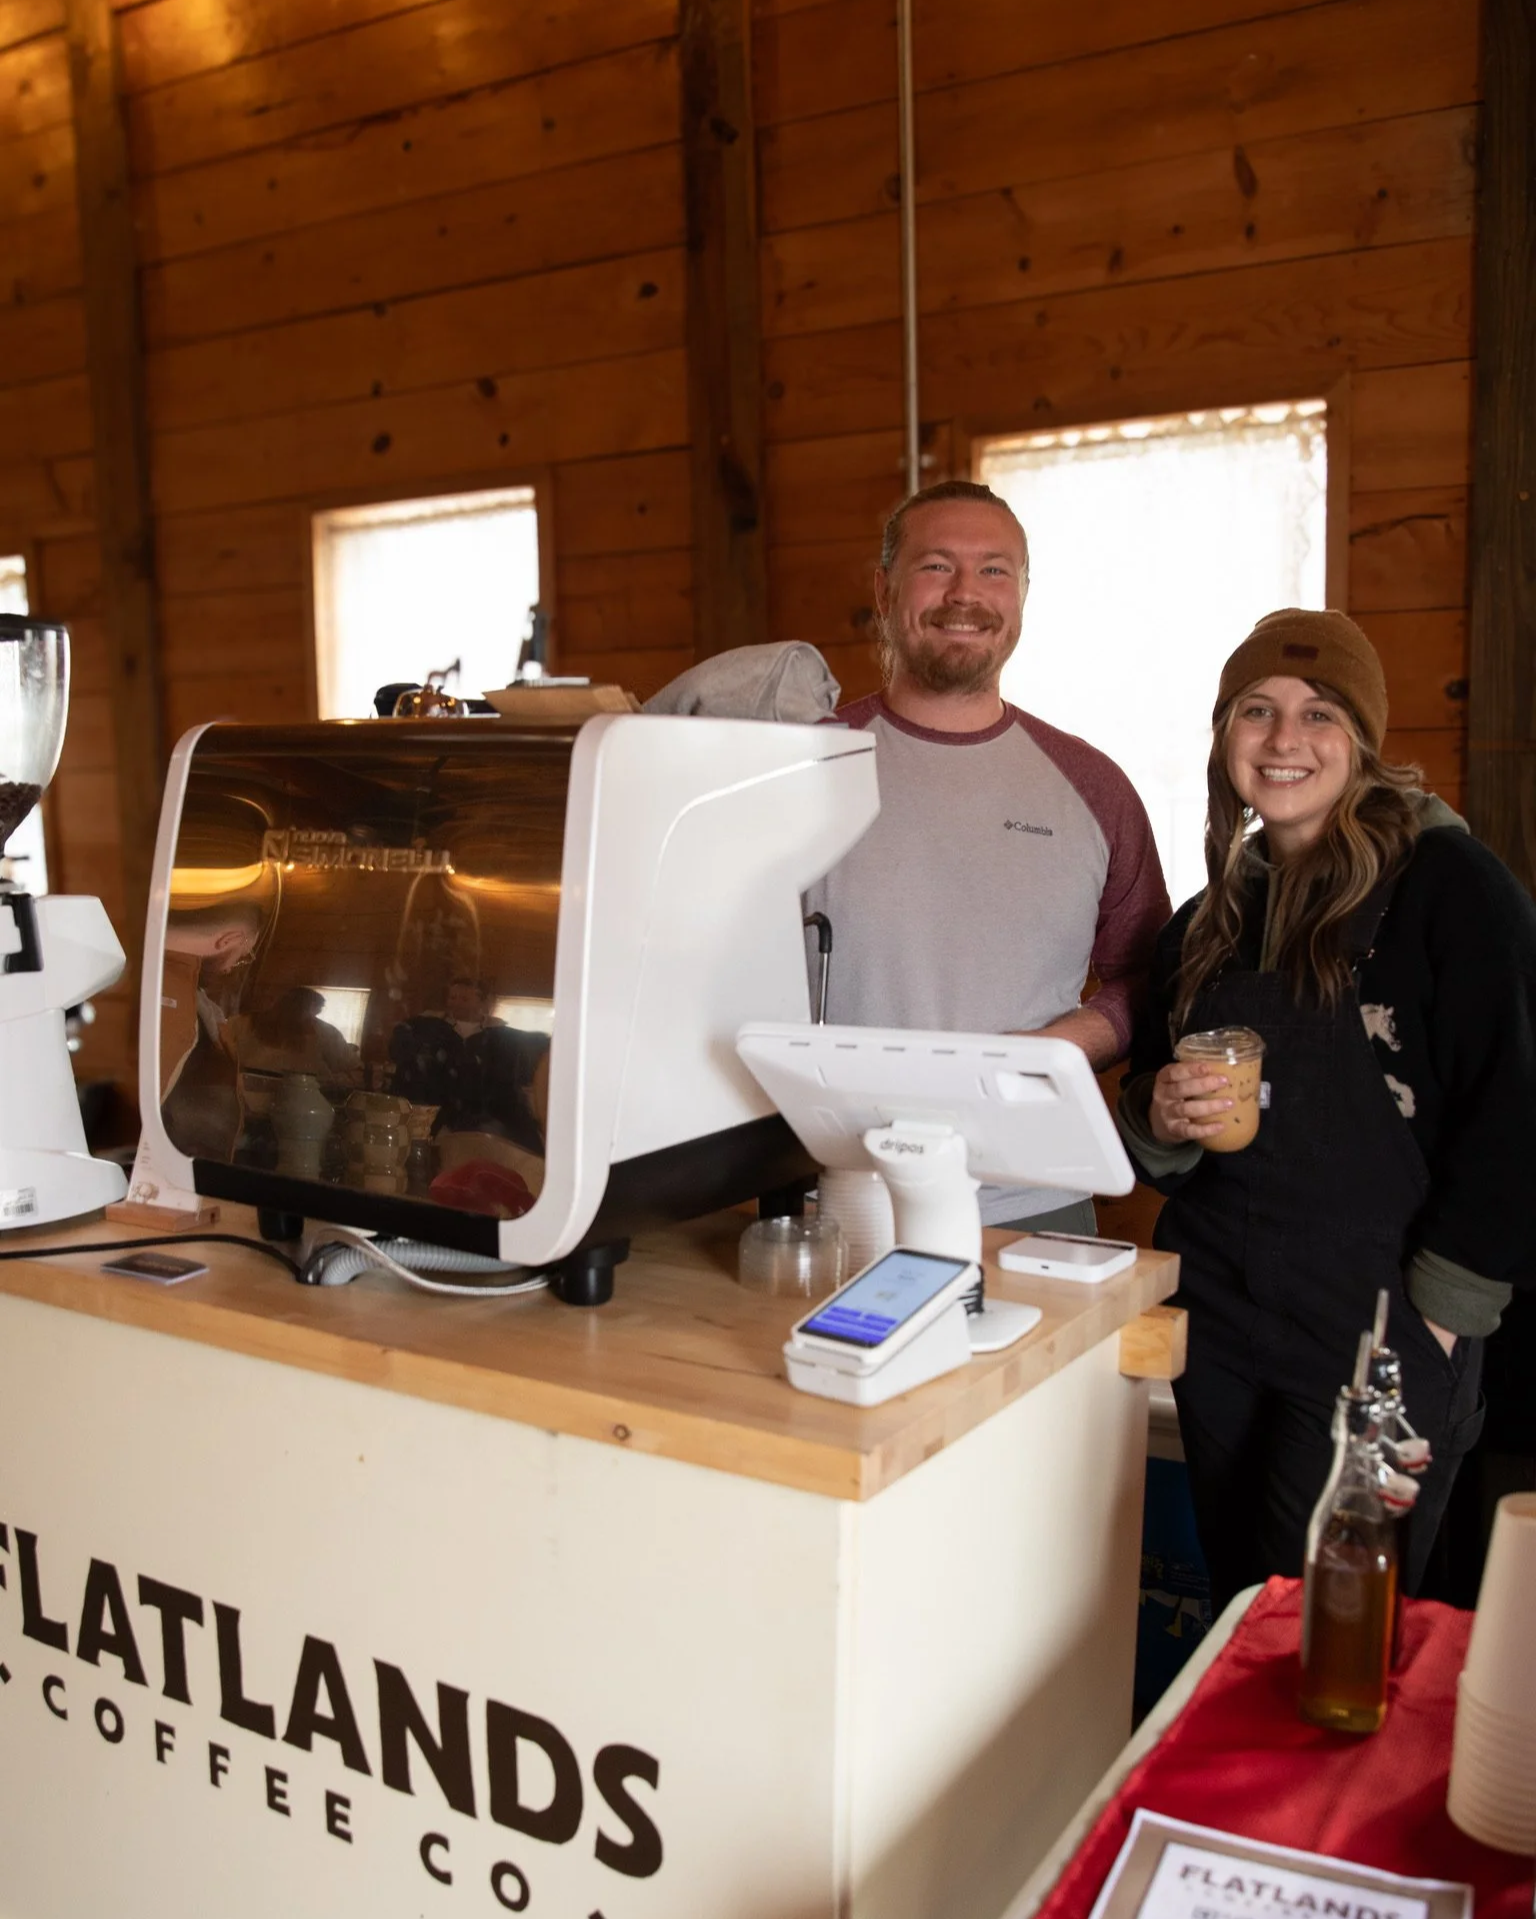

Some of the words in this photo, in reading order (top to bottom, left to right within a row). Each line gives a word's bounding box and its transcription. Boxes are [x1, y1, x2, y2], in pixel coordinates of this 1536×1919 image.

[1013, 821, 1053, 837] Columbia
[879, 1139, 924, 1155] dripos
[41, 1674, 353, 1844] COFFEE
